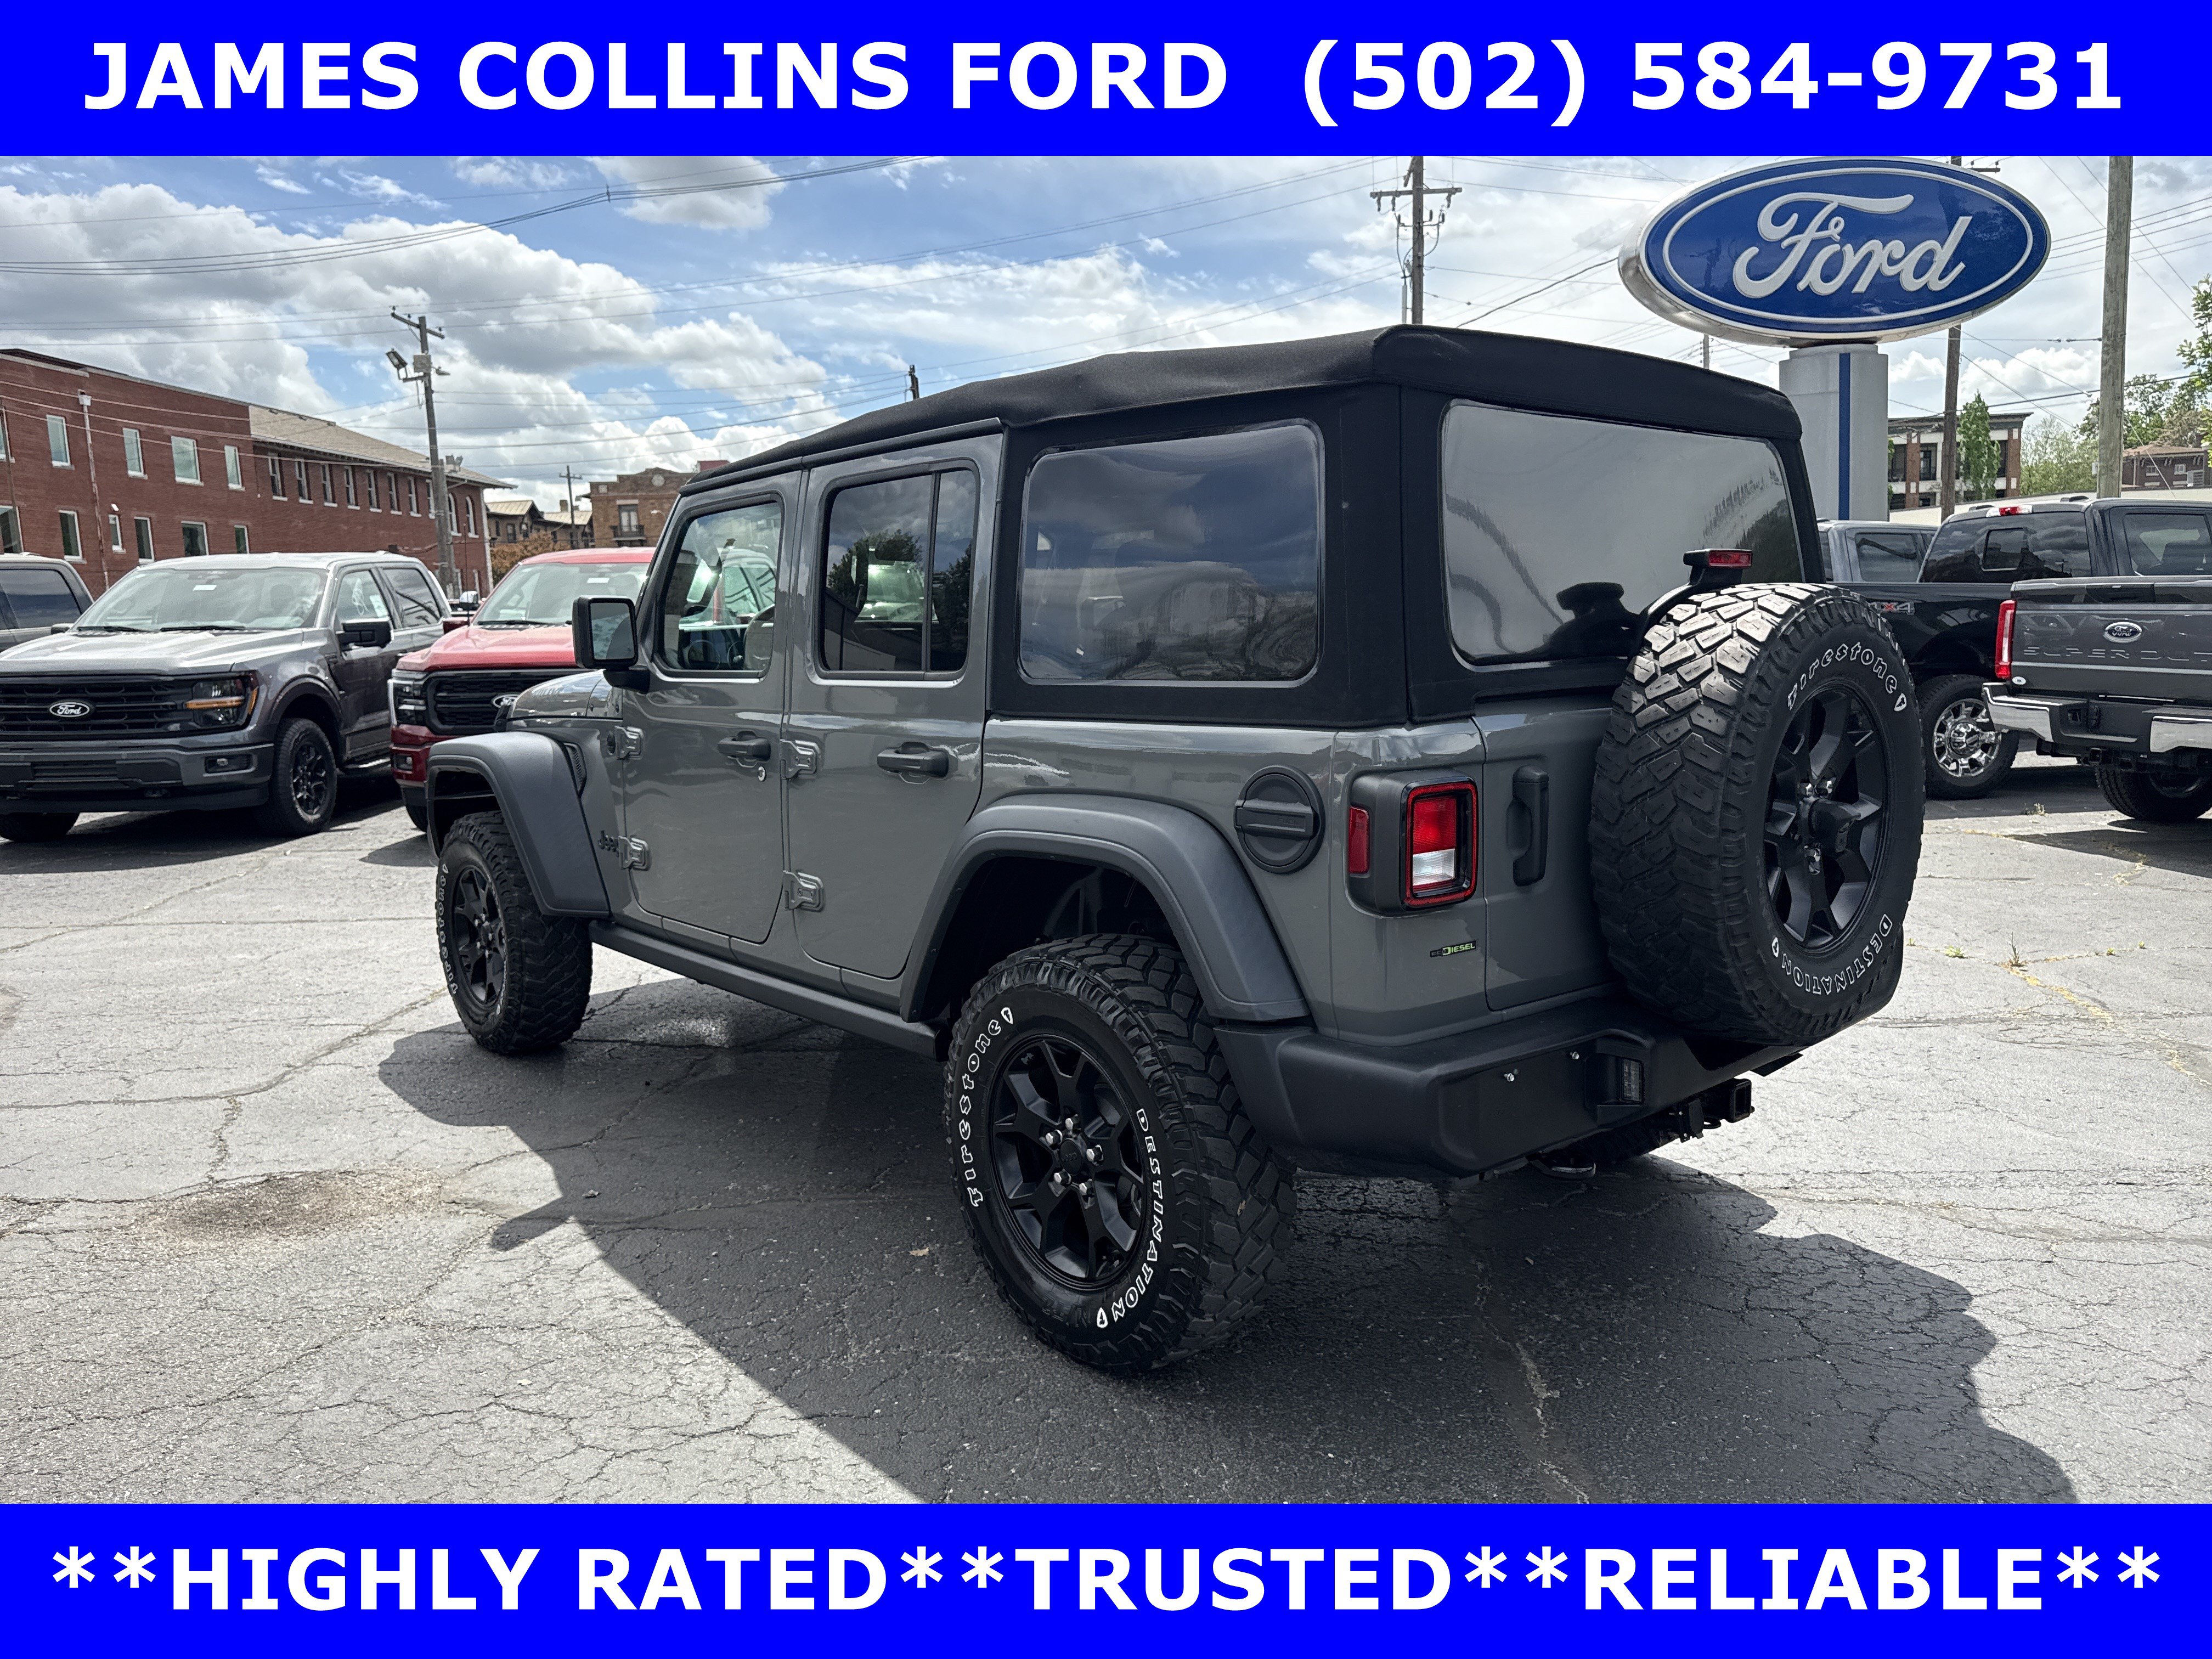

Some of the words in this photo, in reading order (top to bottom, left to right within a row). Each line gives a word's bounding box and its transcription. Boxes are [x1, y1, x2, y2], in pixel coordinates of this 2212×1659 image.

[1733, 191, 1973, 299] Ford
[2023, 646, 2130, 659] SUPER
[2141, 650, 2212, 662] DUT
[2112, 626, 2132, 637] Ford
[57, 704, 82, 715] Ford
[1788, 642, 1898, 711] Firestone
[1781, 913, 1893, 995] DESTINATION
[959, 1019, 1001, 1207] Firestone
[1111, 1108, 1164, 1323] DESTINATION
